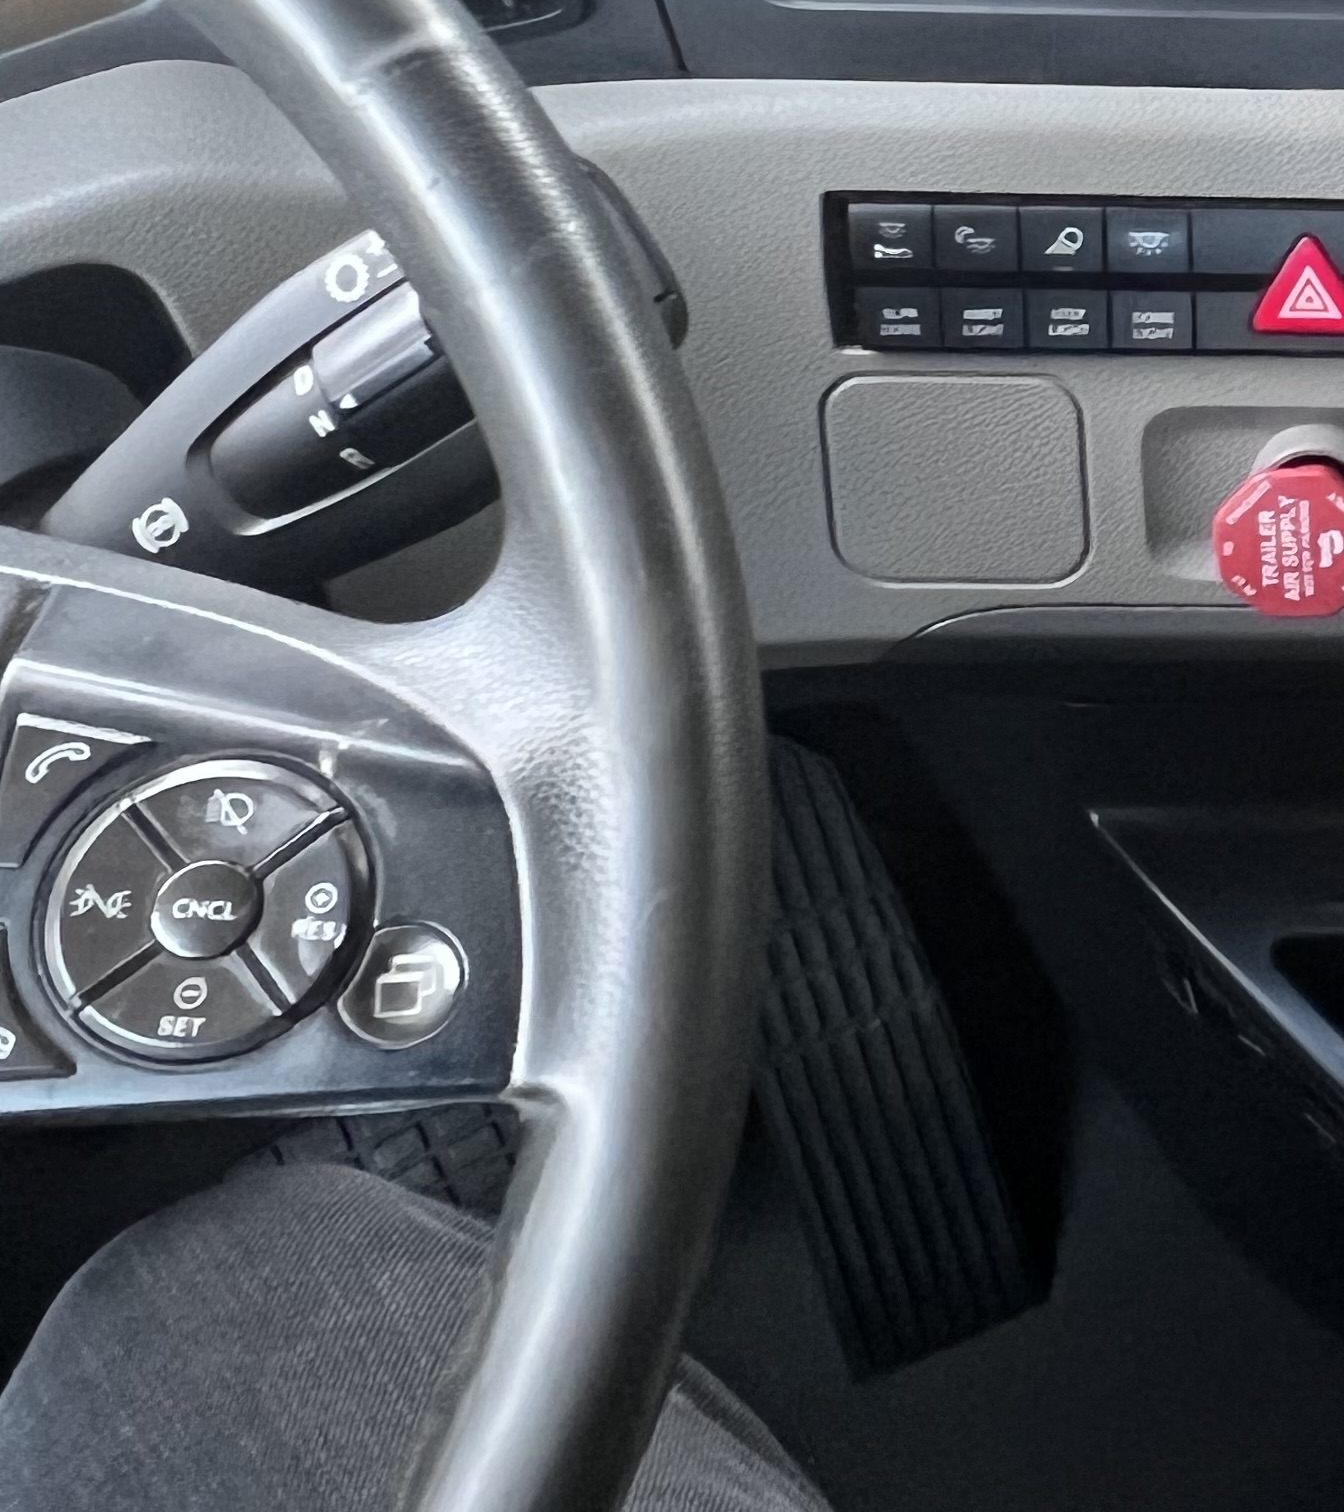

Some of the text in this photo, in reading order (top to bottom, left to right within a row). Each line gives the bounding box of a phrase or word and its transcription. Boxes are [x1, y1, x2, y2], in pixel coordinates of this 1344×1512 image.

[308, 409, 336, 438] N
[1257, 510, 1280, 587] TRAILER
[1277, 494, 1301, 602] AIR SUPPLY
[171, 897, 238, 922] CNCL
[156, 1014, 207, 1038] SET
